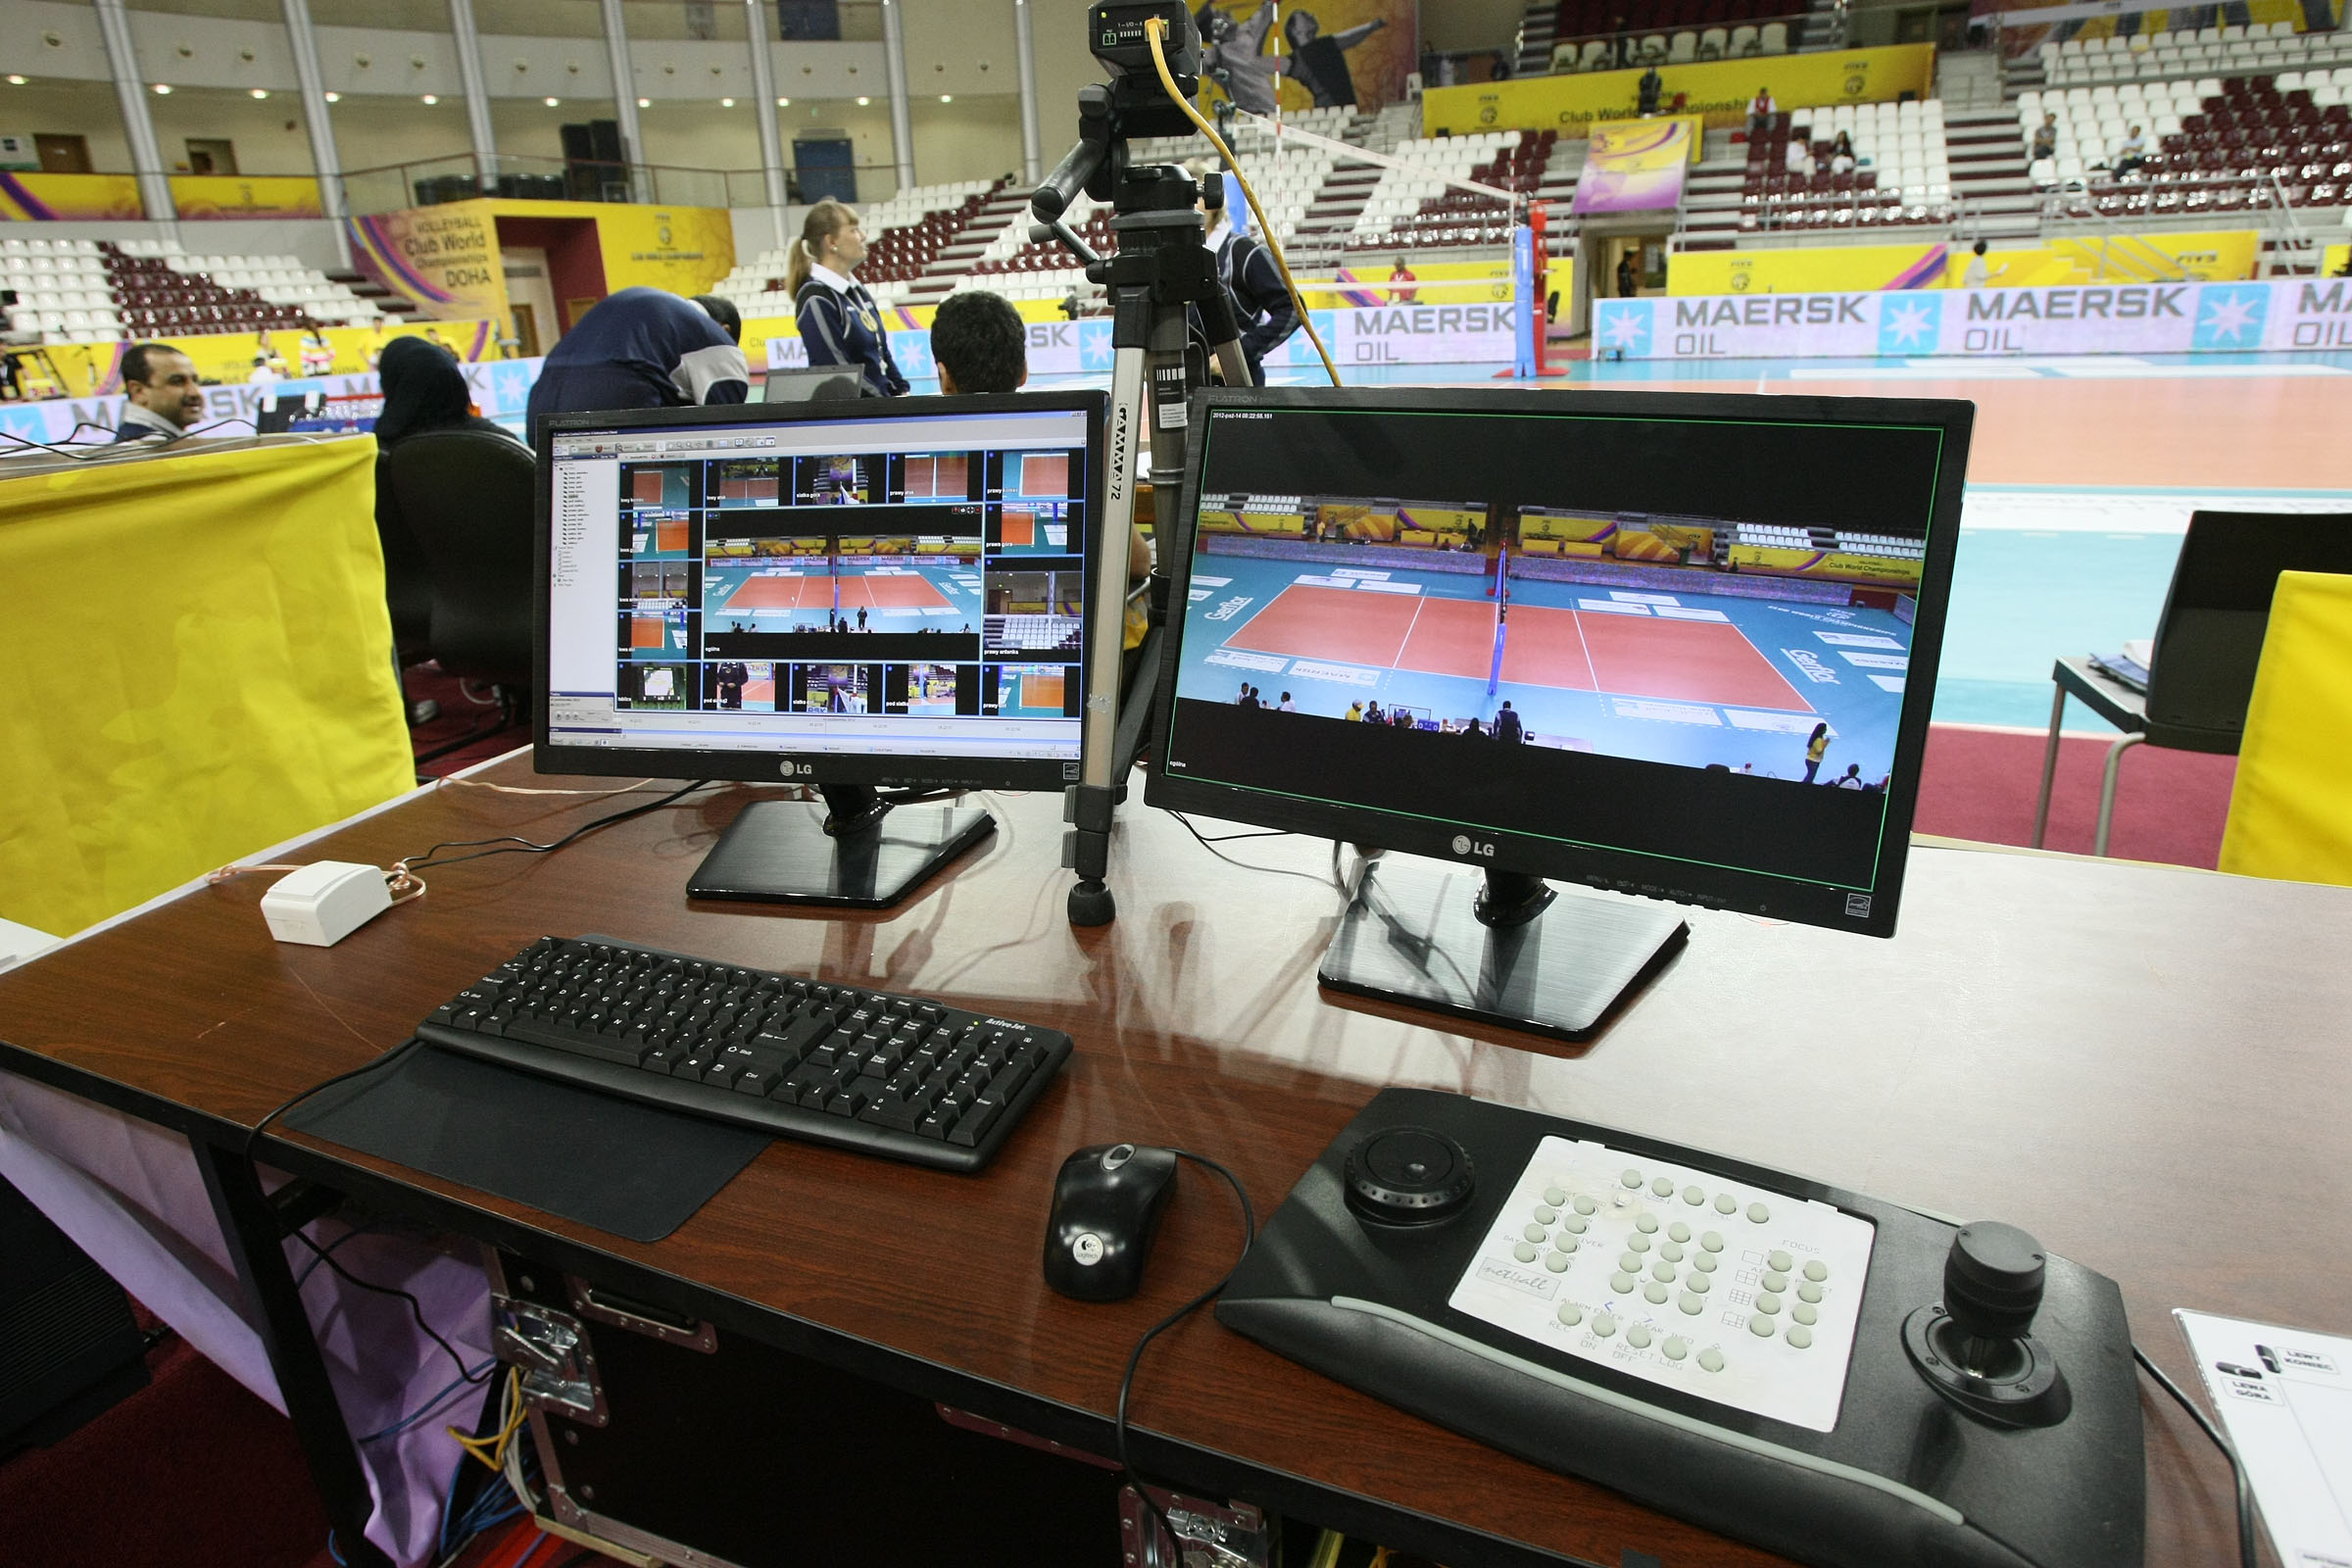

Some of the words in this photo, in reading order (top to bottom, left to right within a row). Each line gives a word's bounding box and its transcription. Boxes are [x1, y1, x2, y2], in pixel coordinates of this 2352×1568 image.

[1559, 110, 1594, 124] Club
[404, 237, 439, 256] Club
[441, 231, 487, 251] World
[445, 268, 492, 288] DOHA
[1676, 294, 1868, 327] MAERSK
[1966, 286, 2189, 320] MAERSK
[1354, 306, 1516, 336] MAERSK
[1675, 333, 1726, 355] OIL
[1964, 328, 2023, 351] OIL
[1356, 342, 1399, 362] OIL
[1207, 394, 1258, 404] FLATRON
[1111, 484, 1122, 500] 72
[796, 764, 812, 774] LG
[1473, 842, 1495, 857] LG
[1782, 1239, 1820, 1254] FOCUS
[1548, 1321, 1572, 1333] REC
[1632, 1320, 1665, 1334] CLEAR
[1580, 1339, 1597, 1350] ON
[1584, 1331, 1607, 1343] SET
[1612, 1350, 1636, 1363] OFF
[1616, 1341, 1655, 1361] RESET
[1659, 1357, 1684, 1371] LOG
